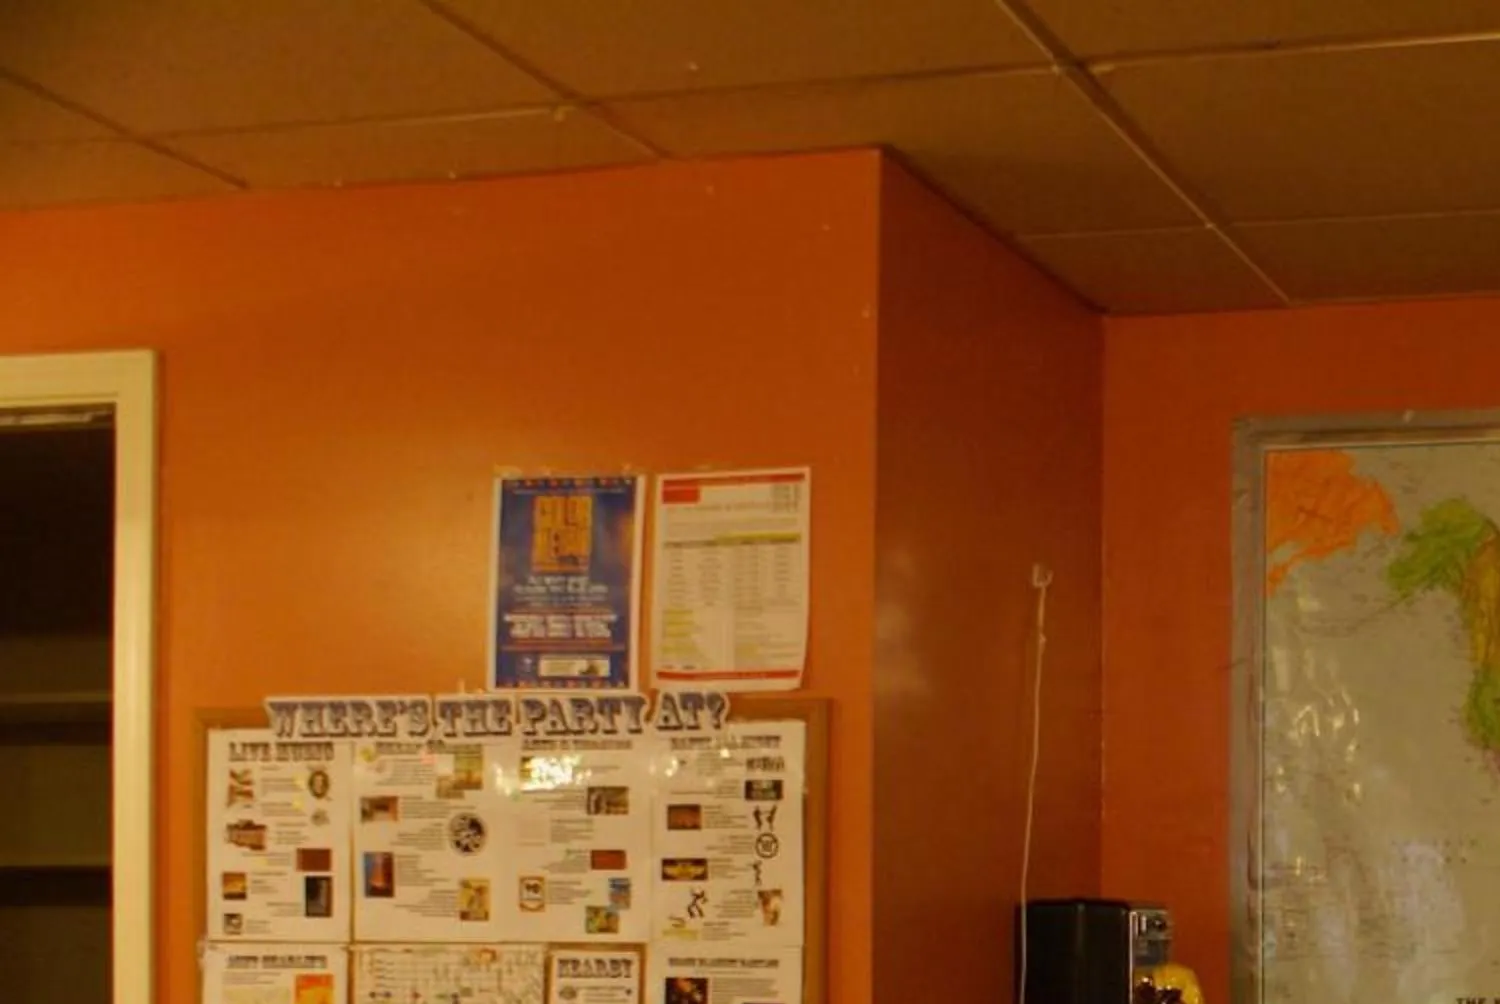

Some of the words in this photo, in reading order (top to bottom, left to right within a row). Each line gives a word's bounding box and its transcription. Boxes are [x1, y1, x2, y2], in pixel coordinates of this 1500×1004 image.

[268, 700, 430, 738] WHERE'S
[439, 699, 513, 737] THE
[521, 696, 648, 735] PARTY
[656, 692, 728, 730] AT?
[227, 741, 272, 762] LIVE
[557, 957, 634, 979] NEARBY
